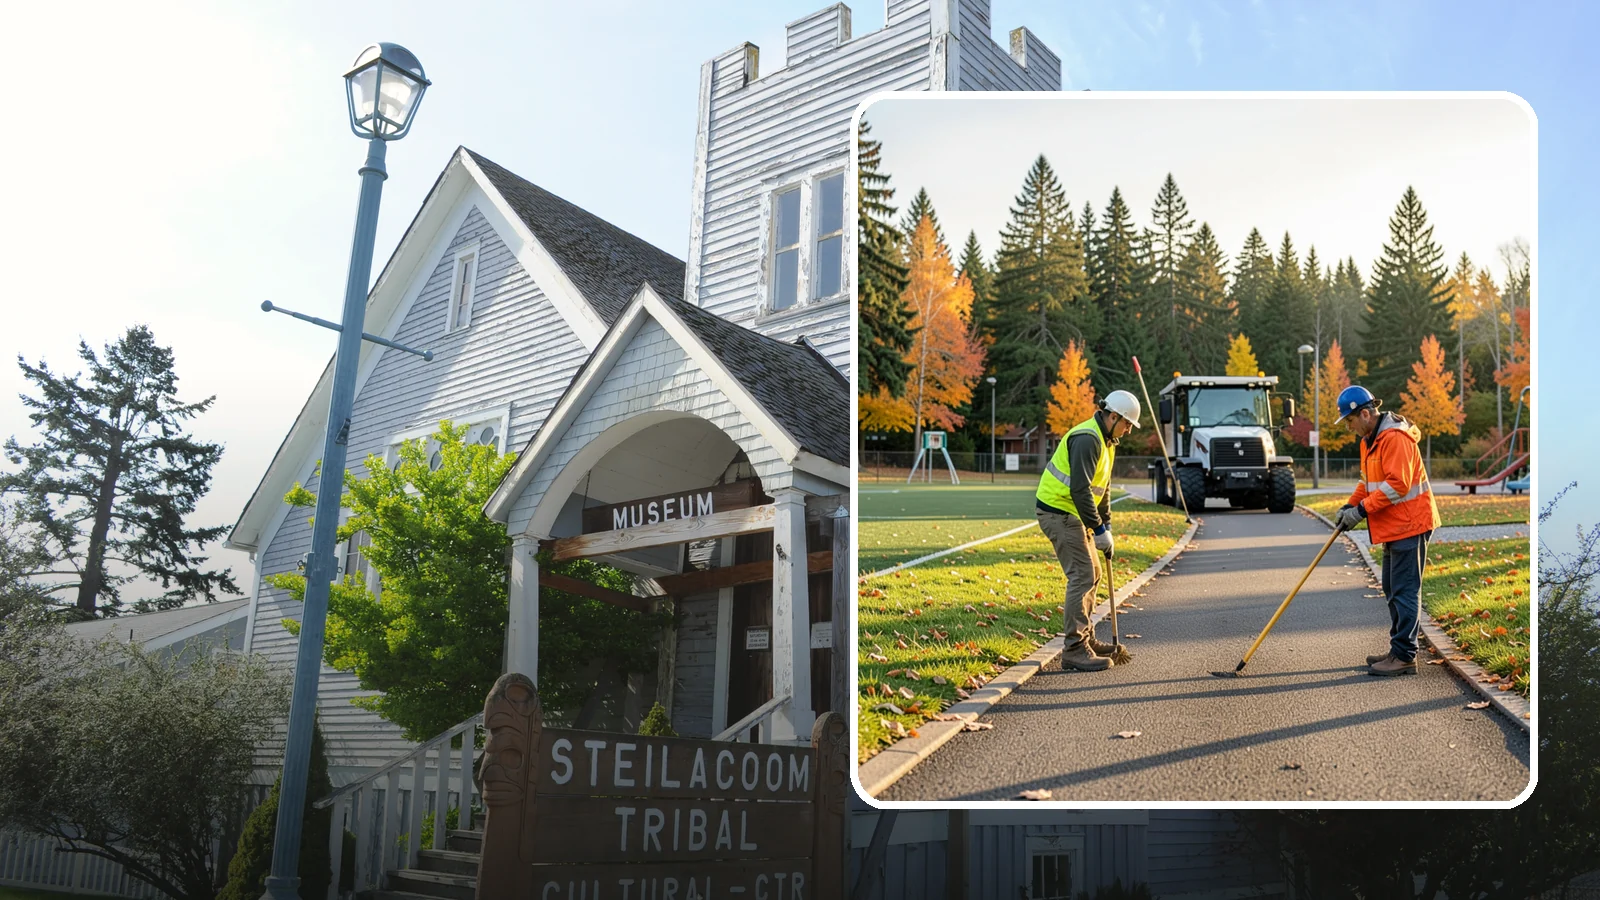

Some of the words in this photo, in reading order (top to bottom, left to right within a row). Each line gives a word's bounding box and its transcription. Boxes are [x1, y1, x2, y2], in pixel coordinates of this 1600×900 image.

[612, 491, 714, 531] MUSEUM
[551, 738, 809, 793] STEILACOOM
[615, 806, 757, 852] TRIBAL
